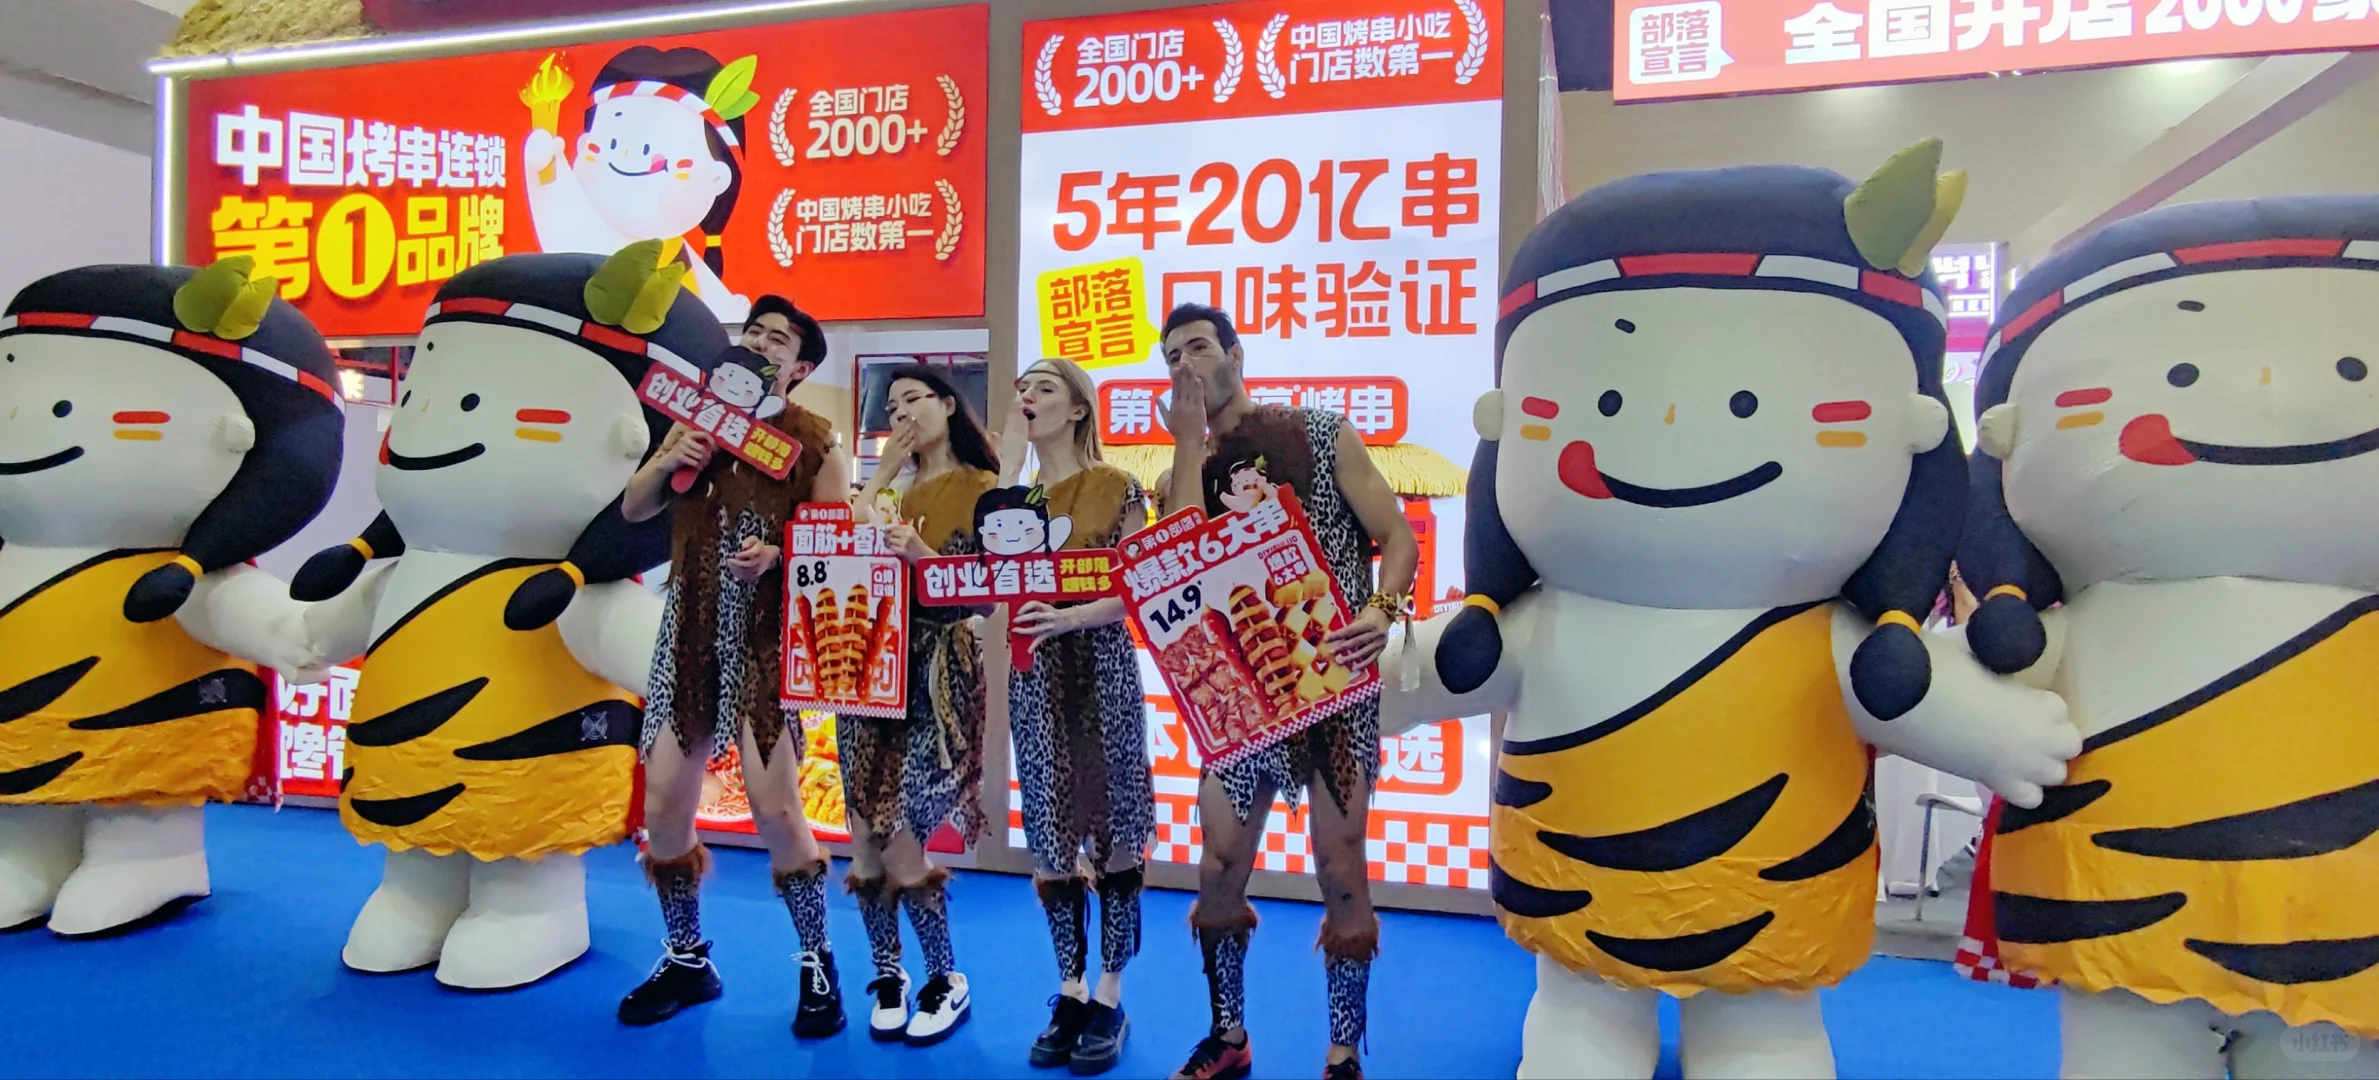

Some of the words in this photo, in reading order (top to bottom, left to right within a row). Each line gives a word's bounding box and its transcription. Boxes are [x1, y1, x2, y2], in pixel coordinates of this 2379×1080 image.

[1077, 30, 1185, 65] 全国门店
[1290, 12, 1452, 51] 中国烤串小吃
[1640, 6, 1710, 45] 部落
[1289, 42, 1455, 85] 门店数第一
[1639, 42, 1710, 77] 宣言
[808, 84, 909, 119] 全国门店
[1074, 61, 1205, 108] 2000+
[215, 105, 507, 188] 中国烤串连锁
[805, 113, 928, 160] 2000+
[796, 192, 932, 223] 中国烤串小吃
[1052, 152, 1480, 252] 5年20亿串
[795, 221, 936, 256] 门店数第一
[1050, 267, 1132, 320] 部落
[1161, 257, 1478, 339] 口味验证
[1052, 312, 1136, 363] 宣言
[645, 371, 751, 448] 创业首选
[1122, 498, 1290, 603] 爆款6大串
[923, 558, 1057, 599] 创业首选
